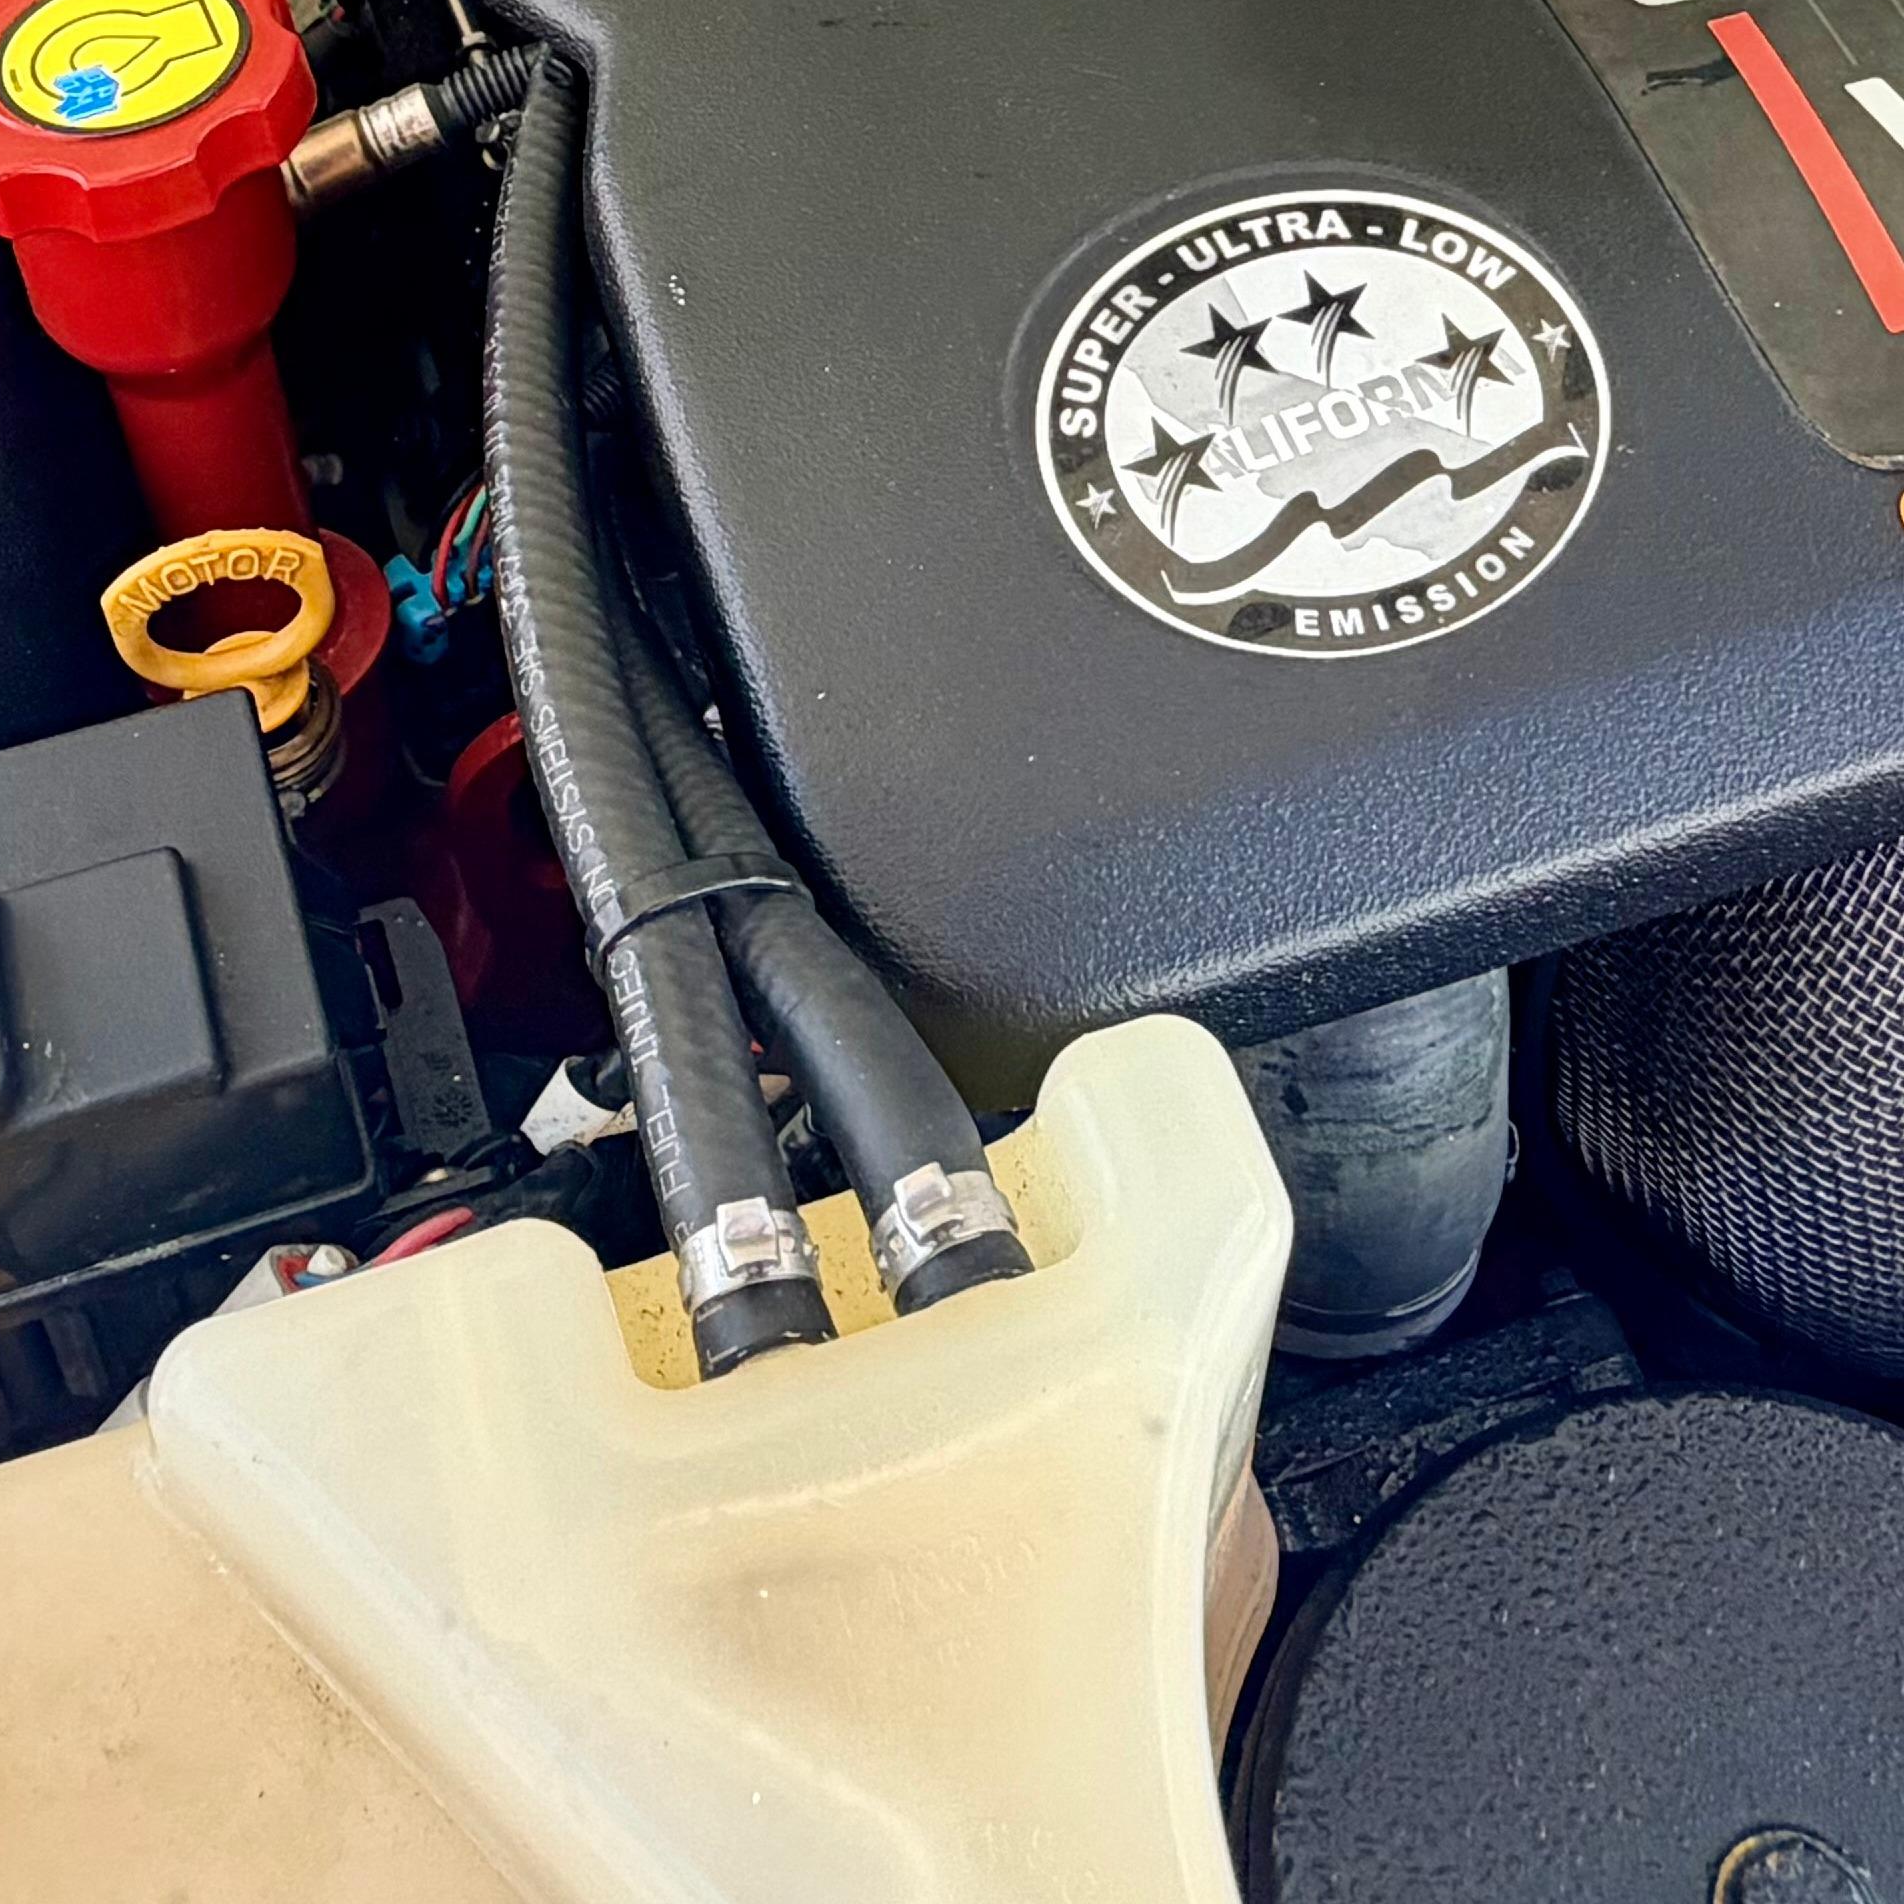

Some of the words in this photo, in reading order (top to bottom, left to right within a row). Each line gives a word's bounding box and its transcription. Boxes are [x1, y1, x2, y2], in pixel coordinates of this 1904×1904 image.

[1059, 283, 1160, 440] SUPER
[1176, 208, 1351, 272] ULTRA
[1398, 217, 1517, 290] LOW
[119, 548, 303, 619] MOTOR
[1294, 526, 1536, 638] EMISSION
[511, 630, 545, 696] SAE
[530, 704, 594, 854] SYSTEMS
[582, 862, 658, 1072] INJECON
[647, 1084, 691, 1203] FUEL
